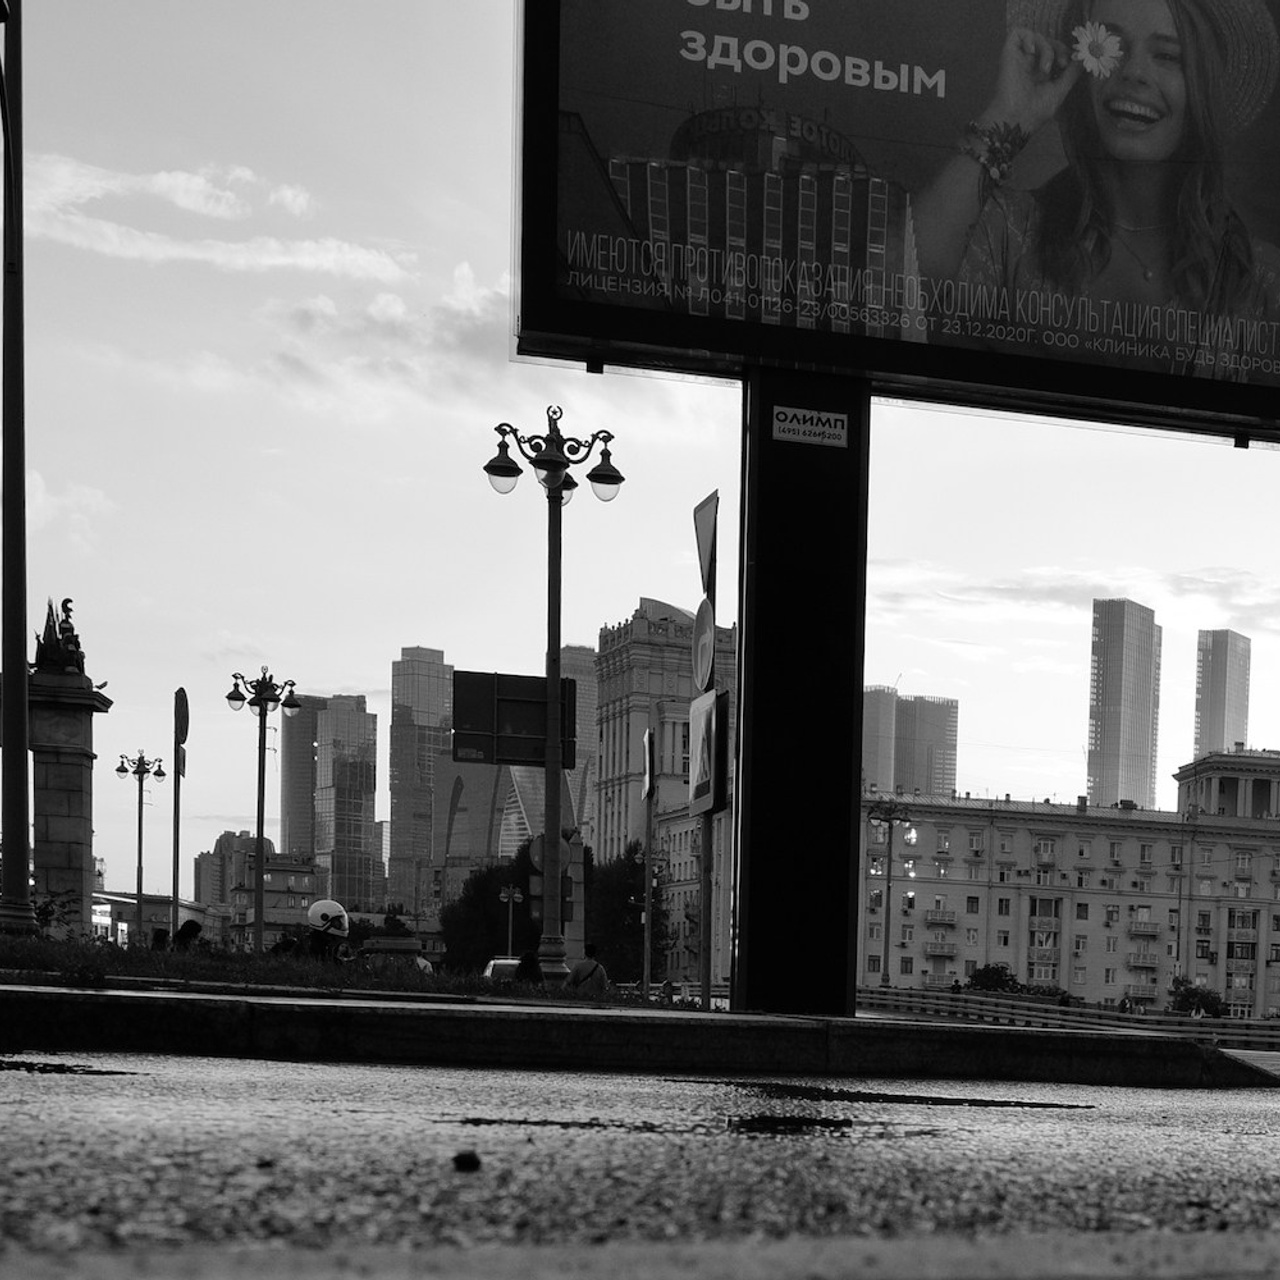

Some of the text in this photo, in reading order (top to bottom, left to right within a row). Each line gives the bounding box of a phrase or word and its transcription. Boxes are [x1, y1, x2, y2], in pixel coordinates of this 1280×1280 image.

[679, 30, 946, 98] здоровым
[567, 271, 667, 297] ЛИЦЕНЗИЯ
[916, 315, 937, 332] ОТ
[1043, 330, 1079, 349] ООО
[1085, 337, 1171, 360] «КЛИНИКА
[1175, 346, 1215, 367] БУДЬ
[568, 229, 666, 278] ИМЕЮТСЯ
[883, 269, 1010, 322] НЕОБХОДИМА
[1016, 288, 1161, 341] КОНСУЛЬТАЦИЯ
[775, 411, 845, 430] ОЛИМП
